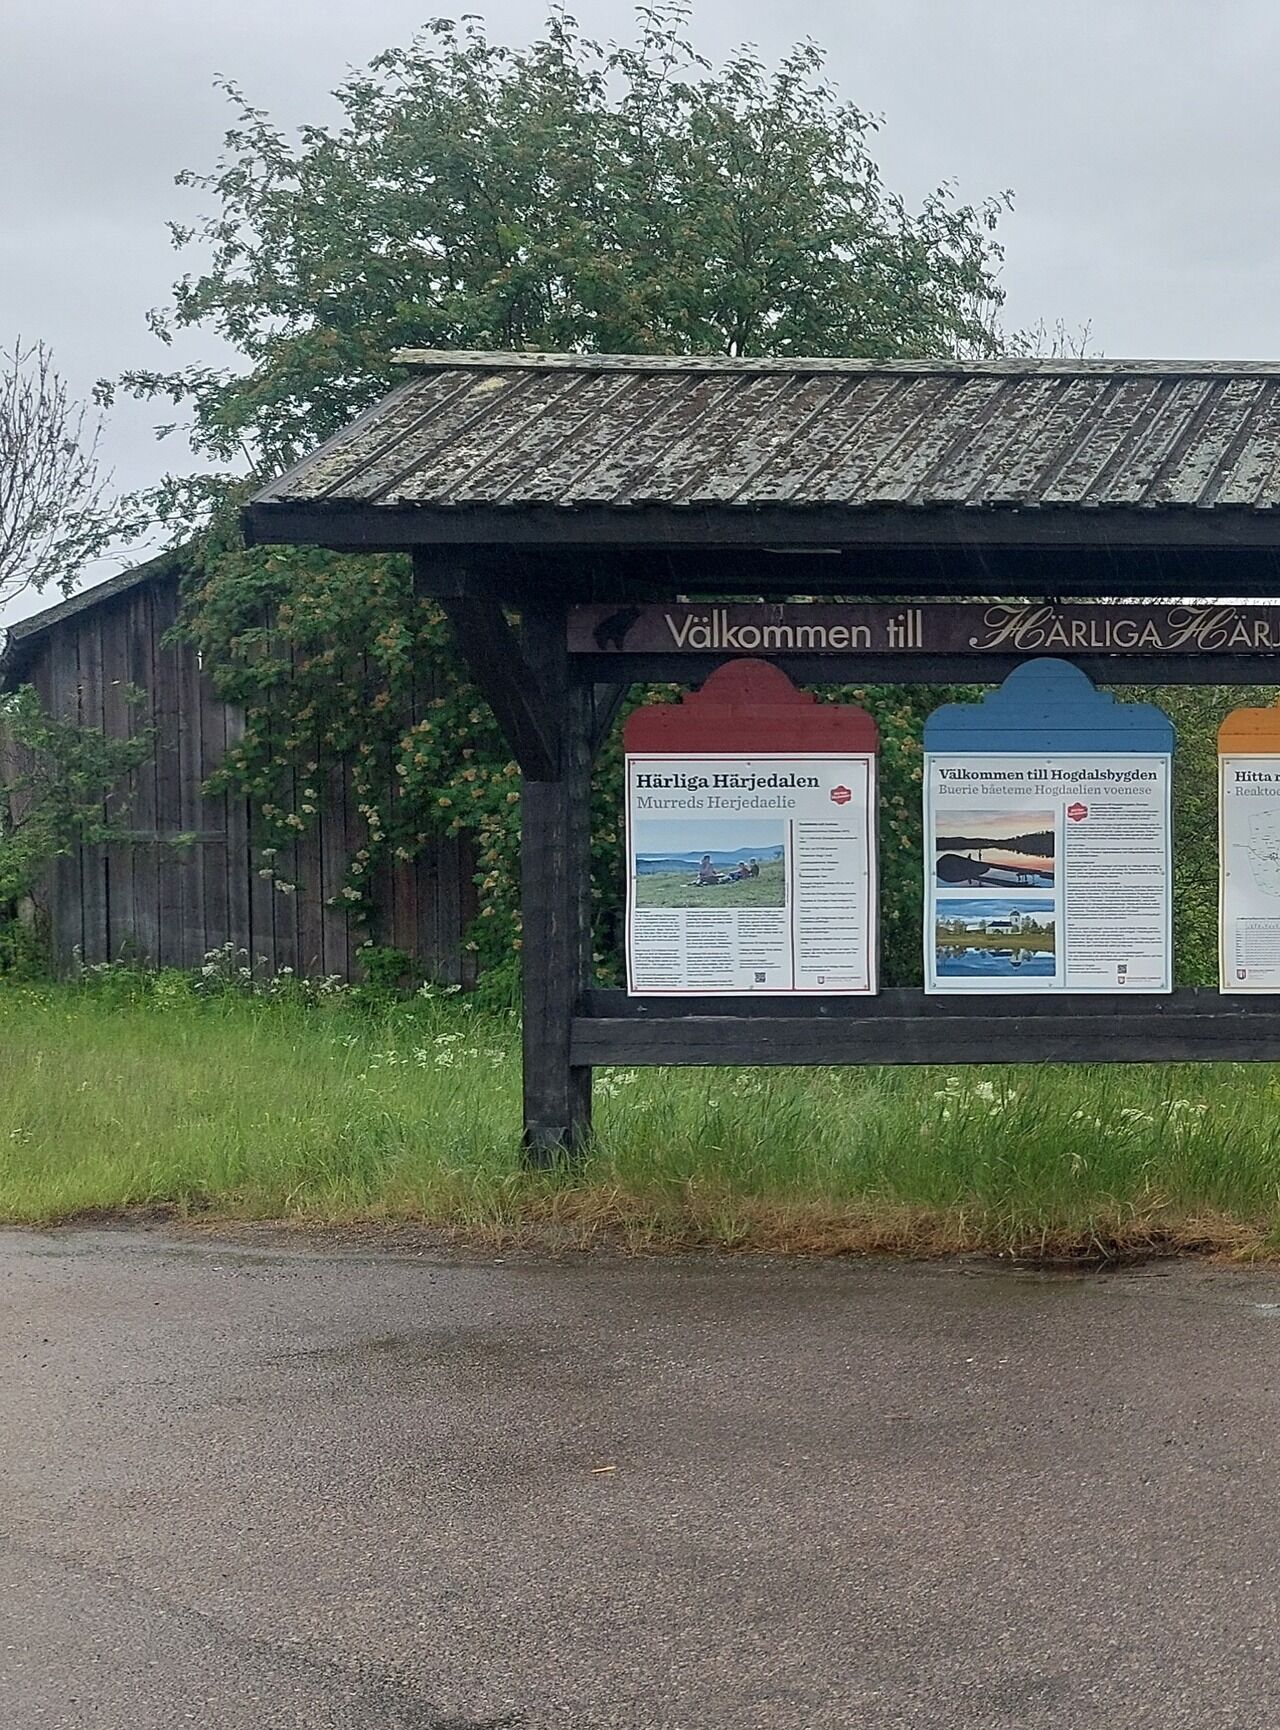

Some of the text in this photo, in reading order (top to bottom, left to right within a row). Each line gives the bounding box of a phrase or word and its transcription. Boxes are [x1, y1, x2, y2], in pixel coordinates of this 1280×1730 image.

[664, 608, 872, 649] Välkommen
[887, 609, 923, 649] till
[969, 604, 1157, 651] HÄRLIGA
[636, 773, 820, 791] Härliga Härjedalen
[939, 768, 1158, 783] Välkommen till Hogdalsbygden
[1234, 770, 1273, 783] Hitta
[938, 783, 979, 796] Buerie
[636, 794, 796, 811] Murreds Herjedaelie
